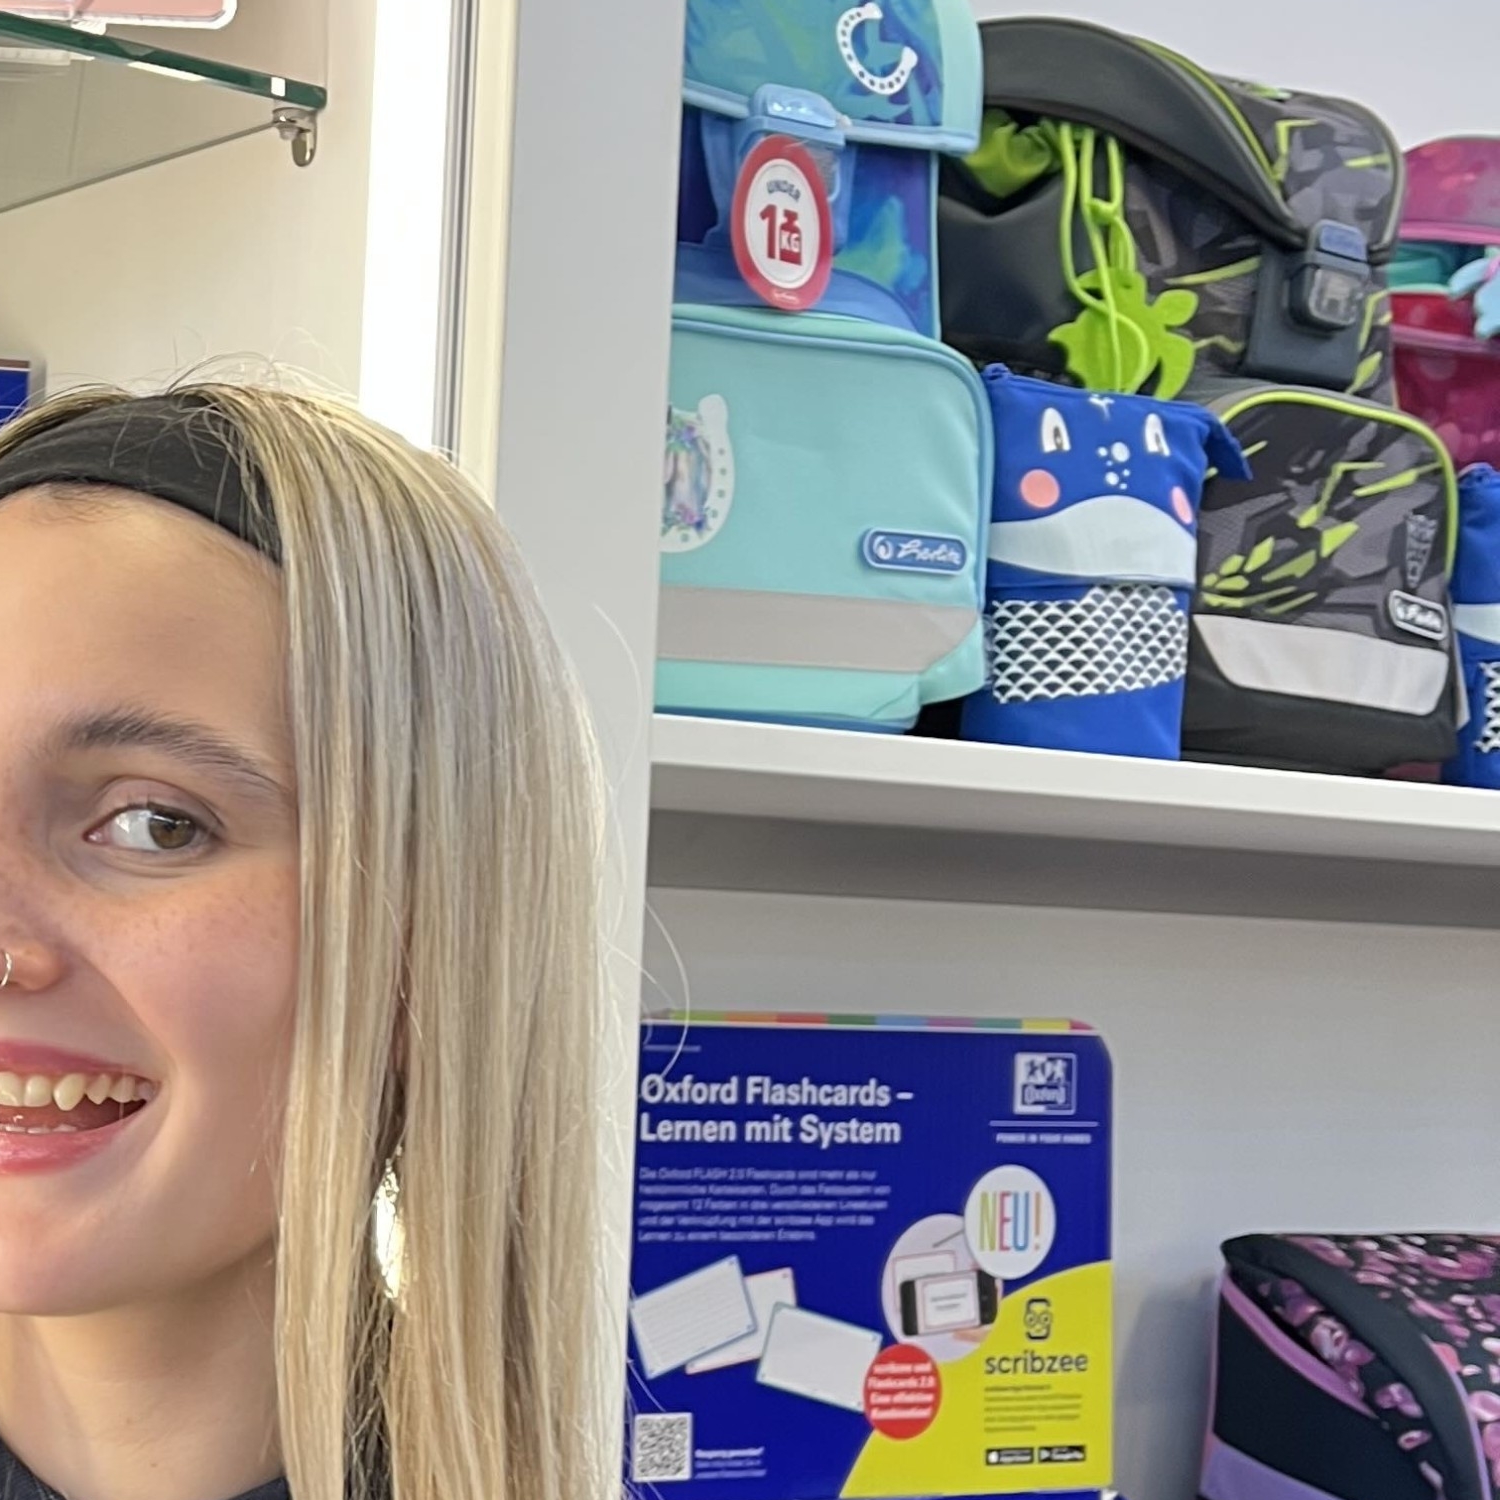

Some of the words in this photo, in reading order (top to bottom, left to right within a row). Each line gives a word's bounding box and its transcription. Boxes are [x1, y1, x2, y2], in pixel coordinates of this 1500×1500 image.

[640, 1073, 738, 1105] Oxford
[746, 1075, 892, 1107] Flashcards
[640, 1112, 737, 1143] Lernen
[744, 1113, 793, 1143] mit
[799, 1113, 902, 1150] System
[979, 1190, 1042, 1252] NEU!
[985, 1350, 1088, 1375] scribzee
